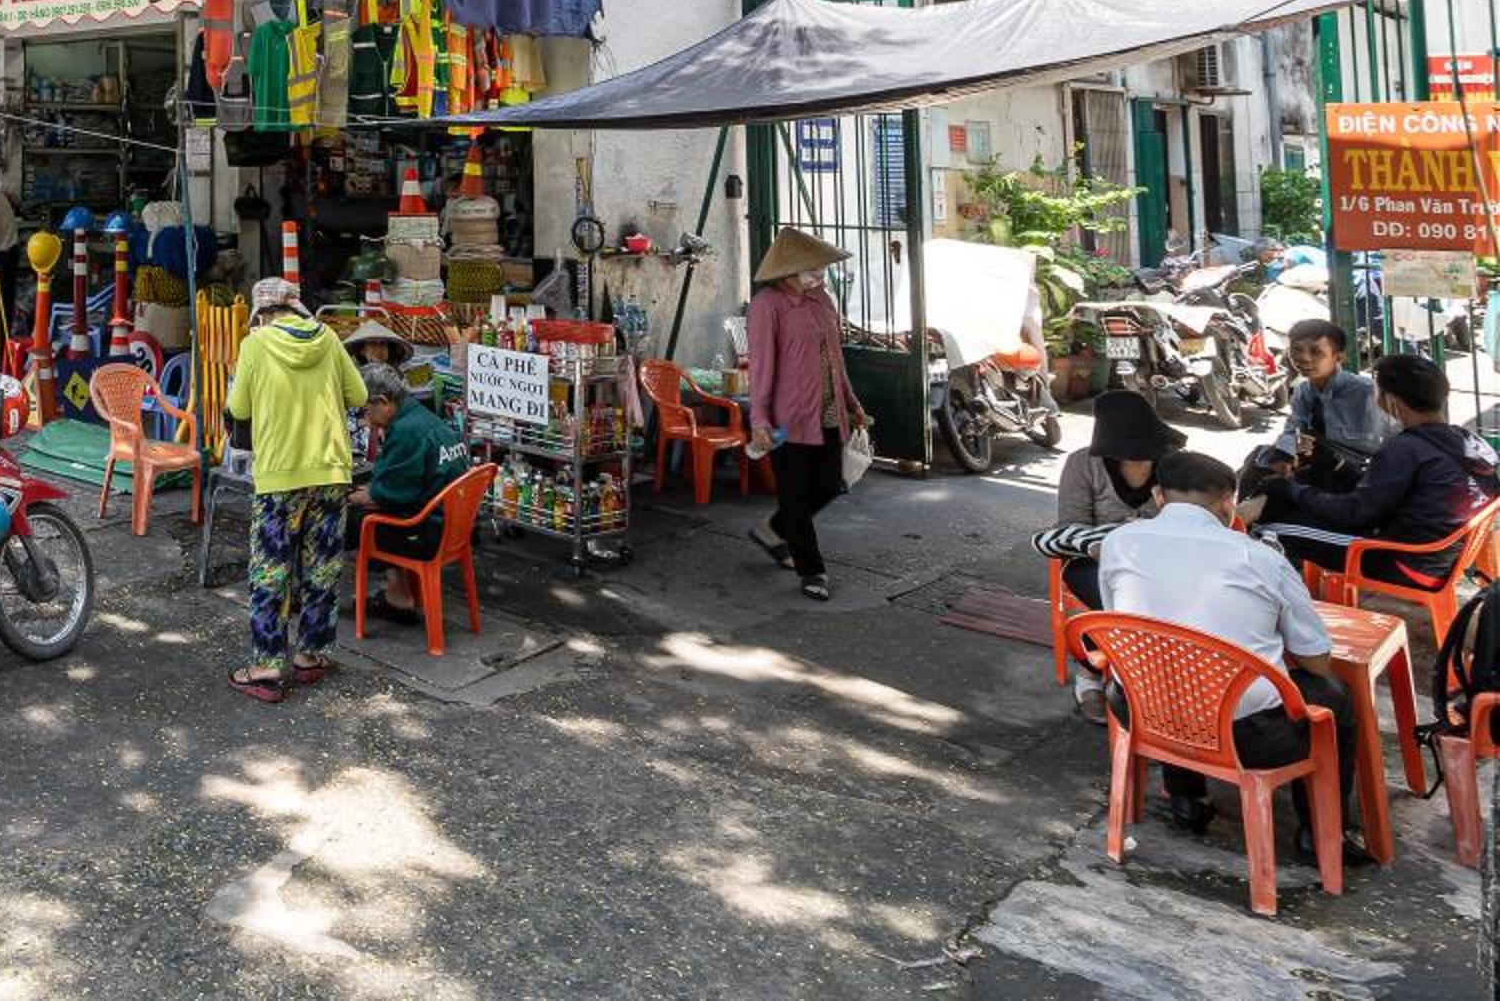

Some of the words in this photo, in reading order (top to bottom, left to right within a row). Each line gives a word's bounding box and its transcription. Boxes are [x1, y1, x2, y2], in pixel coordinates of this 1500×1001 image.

[1338, 111, 1396, 137] ĐIỆN
[1375, 197, 1415, 213] Phan
[1421, 198, 1453, 213] Văn
[1418, 223, 1456, 239] 090
[470, 390, 521, 413] MANG
